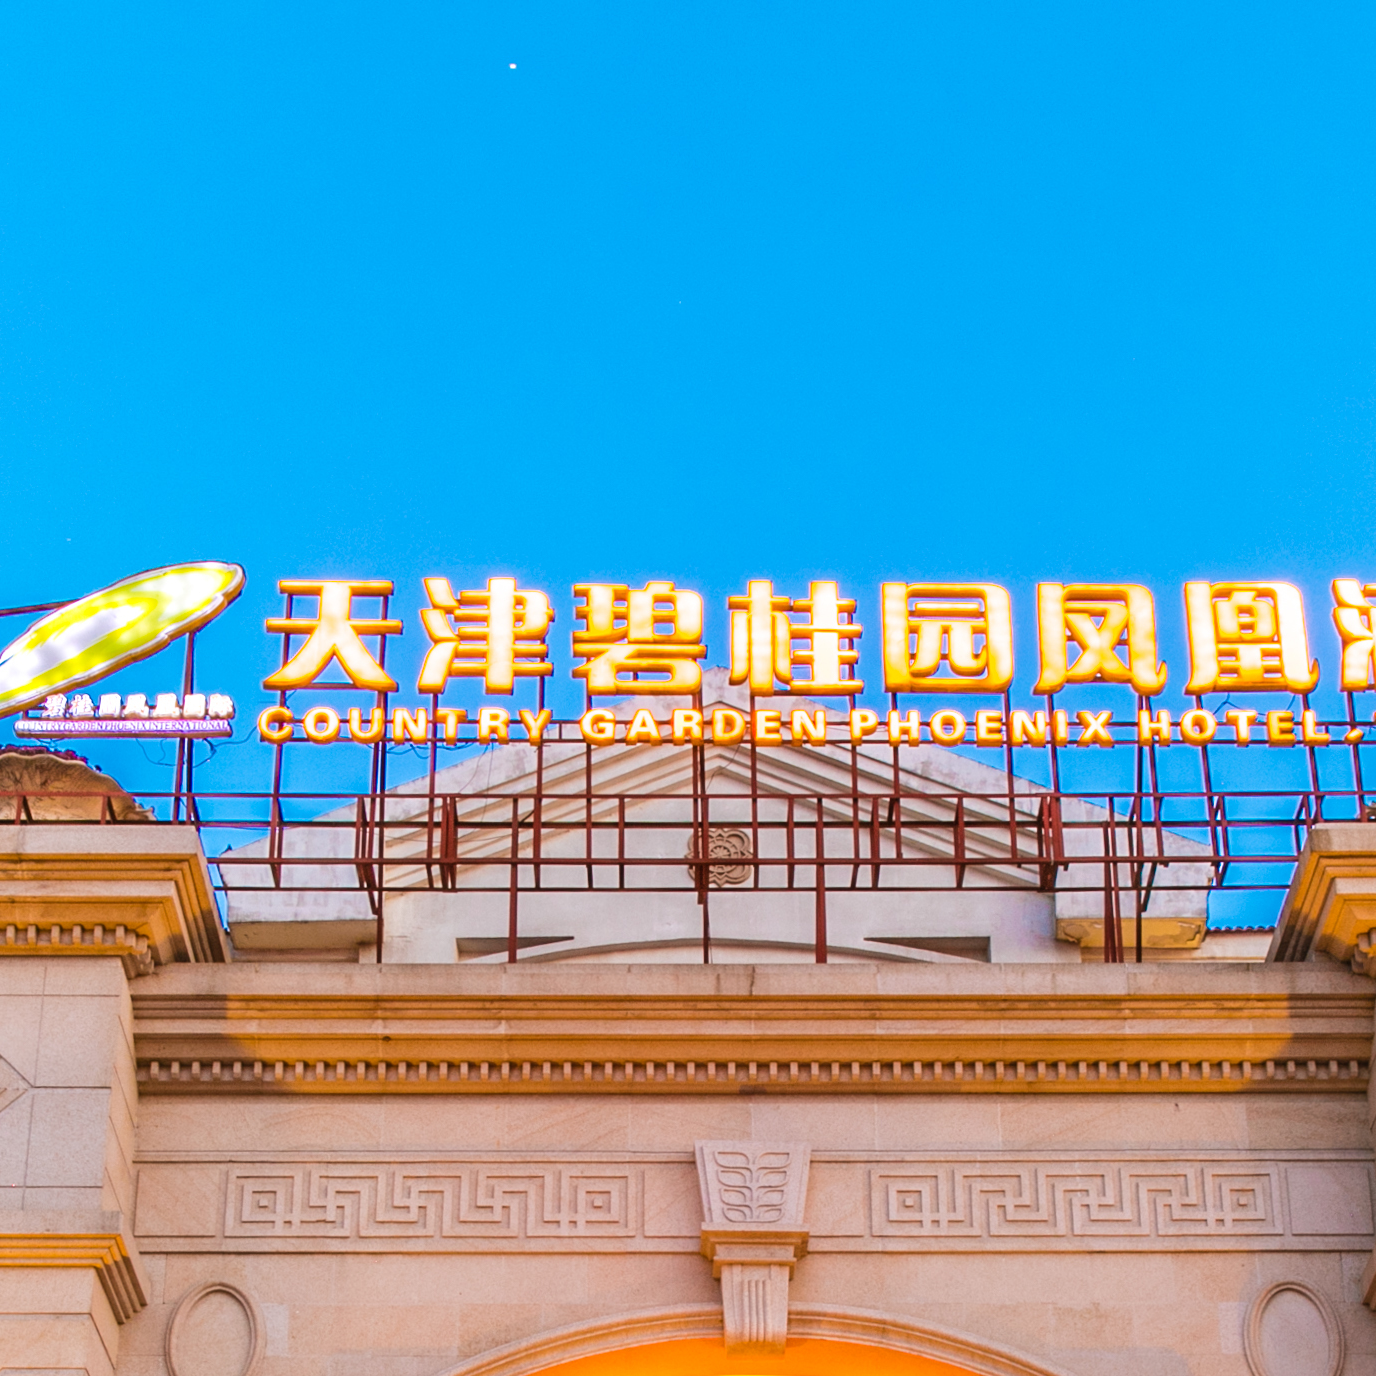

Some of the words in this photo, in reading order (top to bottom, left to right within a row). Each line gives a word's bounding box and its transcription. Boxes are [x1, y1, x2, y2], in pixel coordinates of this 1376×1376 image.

[258, 707, 552, 746] COUNTRY
[580, 708, 827, 747] GARDEN
[849, 709, 1114, 747] PHOENIX
